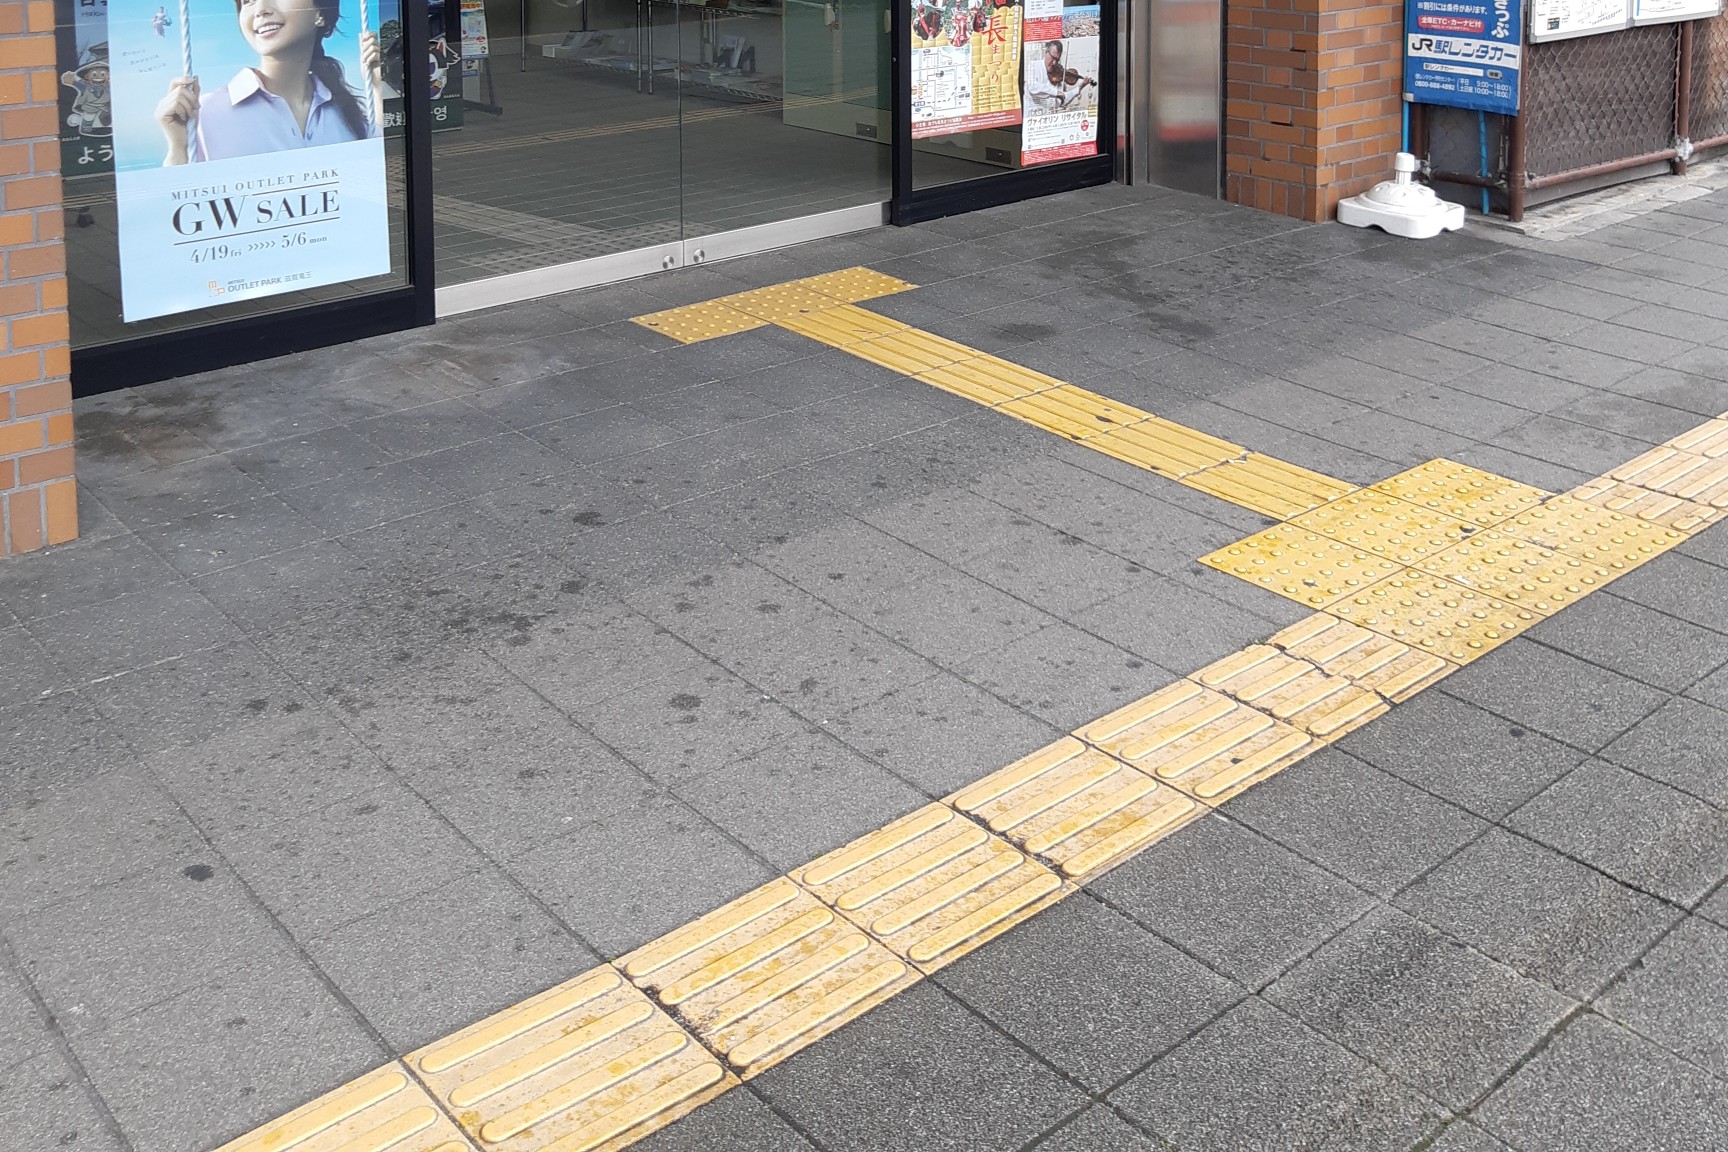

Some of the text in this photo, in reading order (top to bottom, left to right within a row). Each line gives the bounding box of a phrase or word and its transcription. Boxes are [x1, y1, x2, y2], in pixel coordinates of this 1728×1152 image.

[1412, 38, 1518, 62] JR 駅レンタカー
[1027, 111, 1087, 127] ヴァイオリン リサイタル
[171, 168, 339, 201] MITSUI OUTLET PARK
[172, 189, 340, 236] GW SALE
[190, 232, 328, 264] 4/19 fri 5/6 mon
[227, 280, 260, 293] OUTLET
[260, 276, 282, 287] PARK
